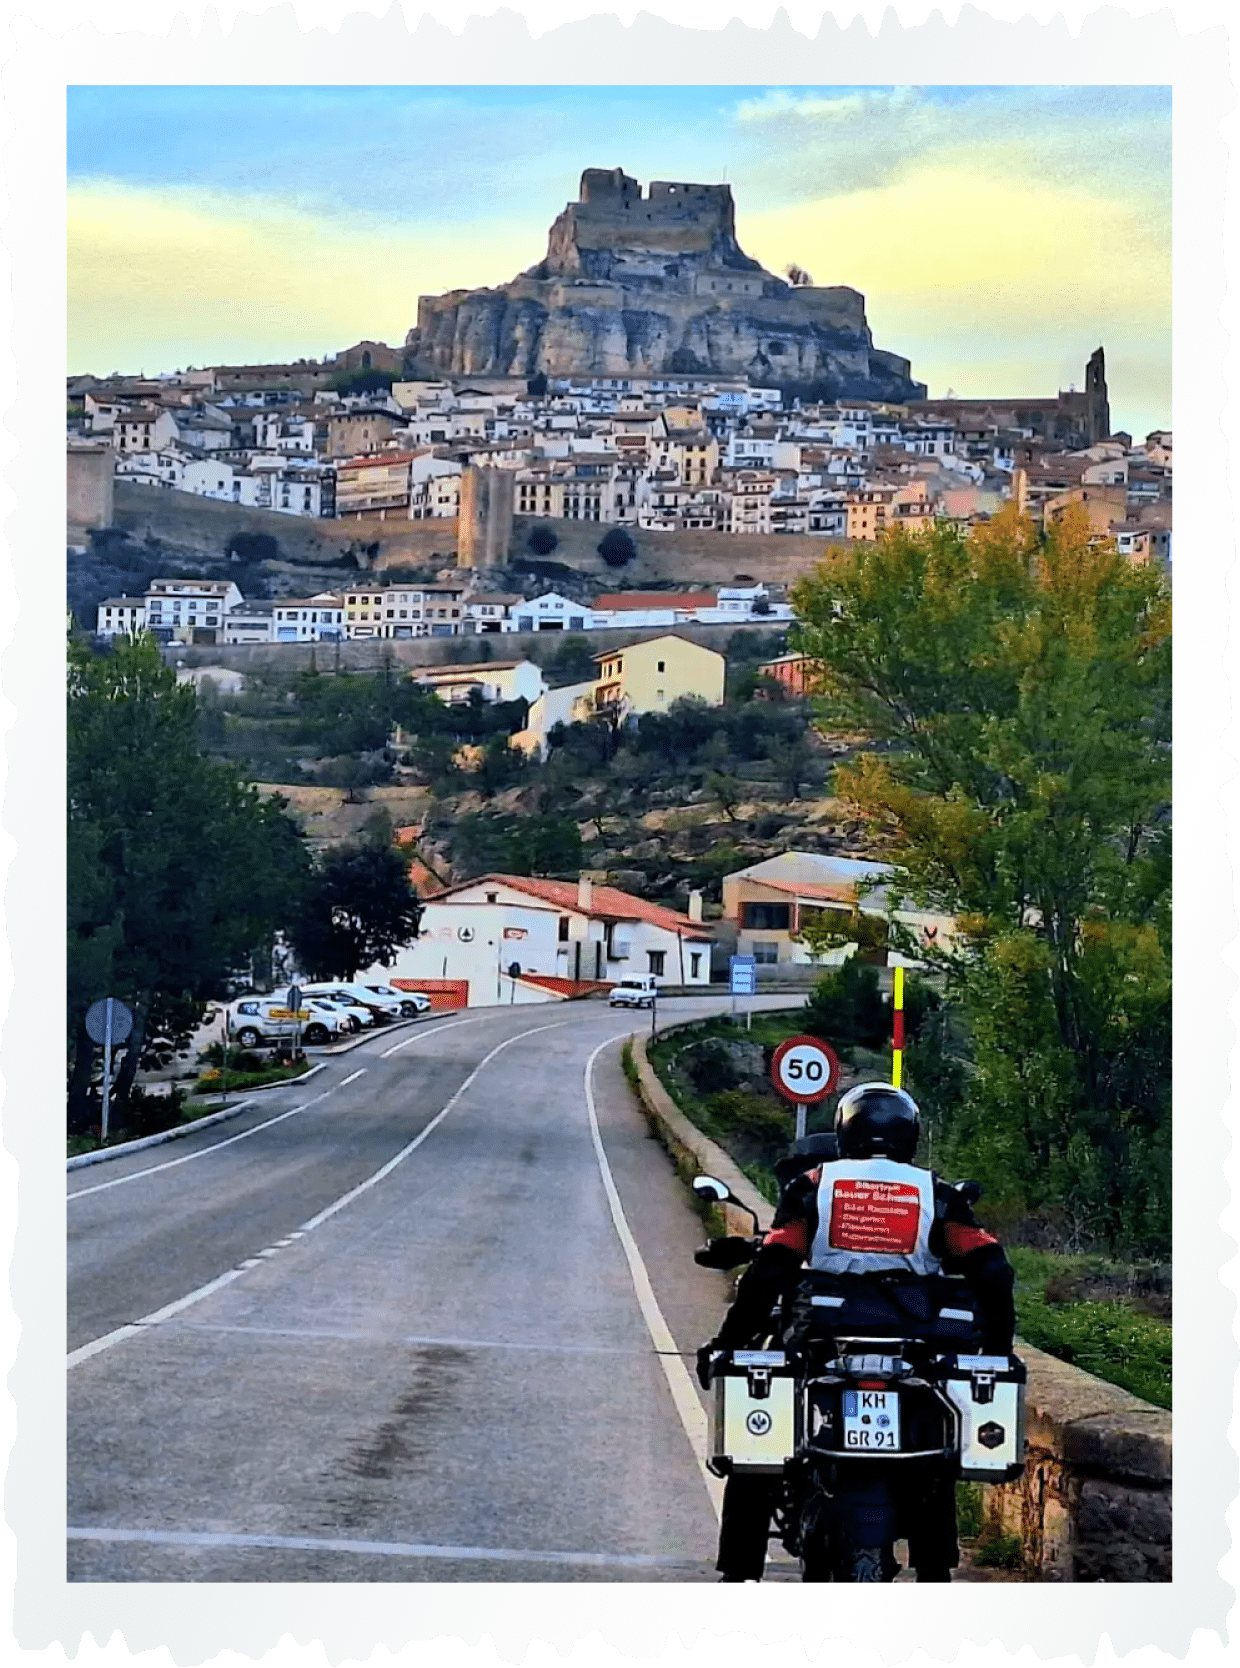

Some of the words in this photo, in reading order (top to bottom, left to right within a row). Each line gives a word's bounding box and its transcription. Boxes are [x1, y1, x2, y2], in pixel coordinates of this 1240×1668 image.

[788, 1059, 822, 1081] 50
[862, 1393, 885, 1408] KH
[847, 1430, 870, 1446] GR
[875, 1431, 895, 1447] 91
